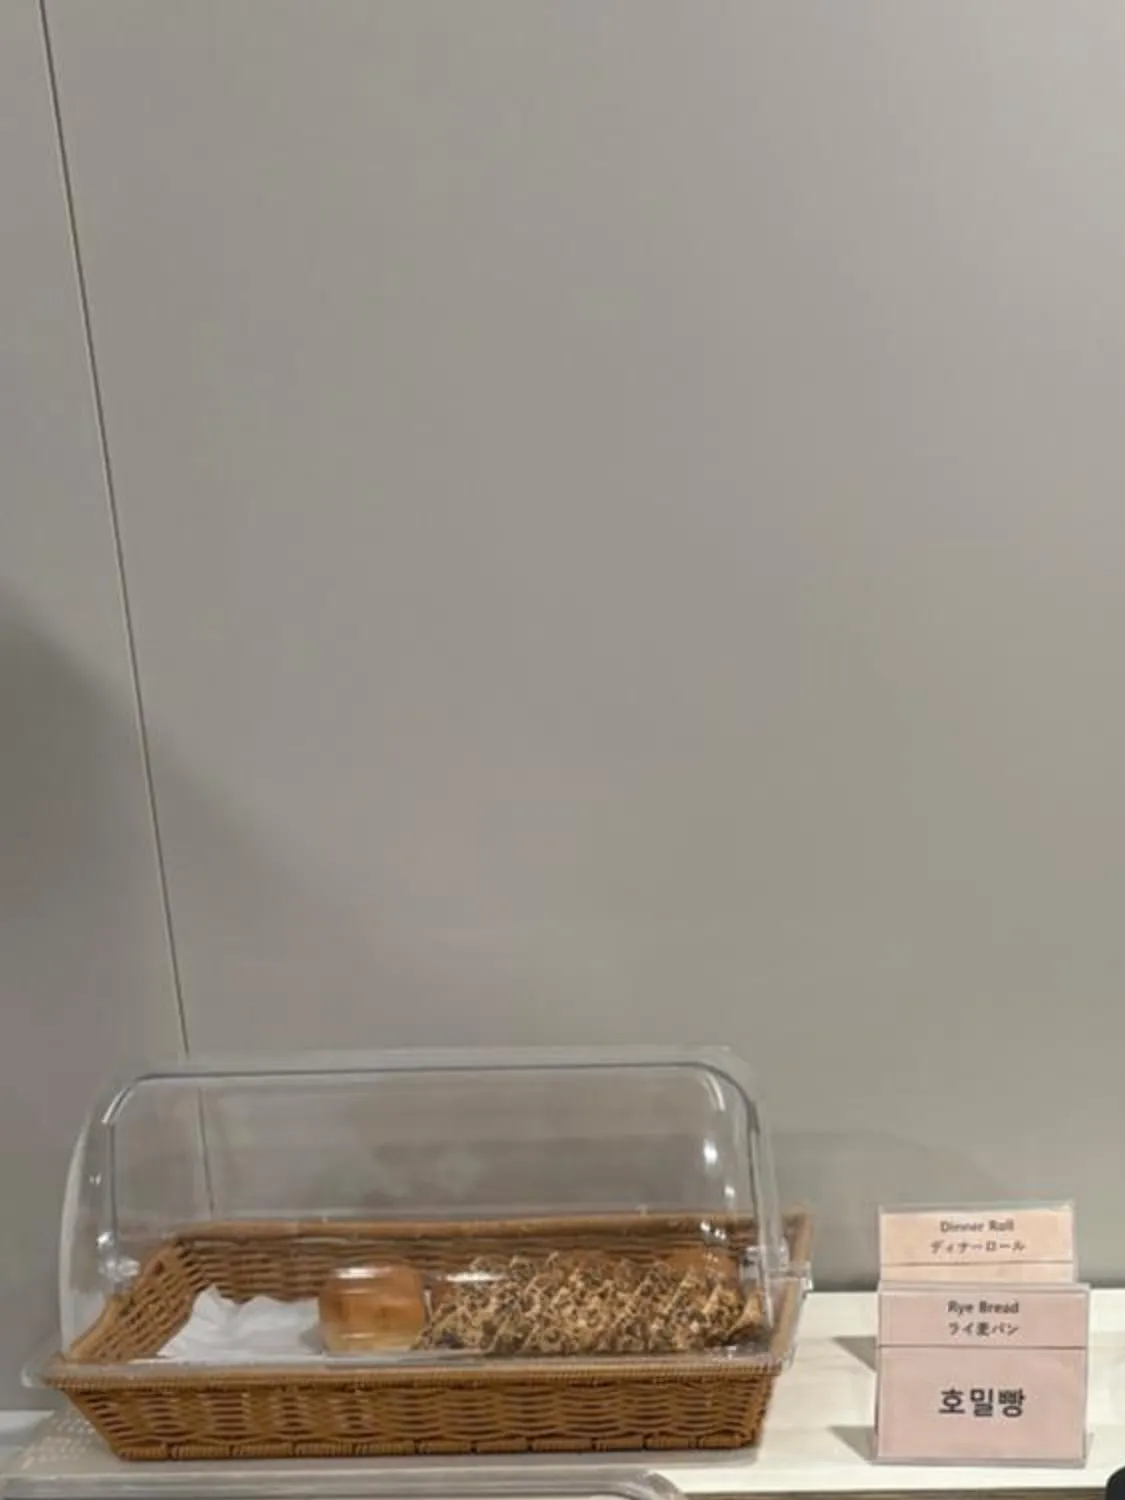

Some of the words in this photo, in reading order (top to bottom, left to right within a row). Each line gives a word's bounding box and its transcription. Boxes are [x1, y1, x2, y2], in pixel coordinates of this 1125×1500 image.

[940, 1220, 984, 1233] Dinner
[947, 1300, 974, 1317] Rye
[979, 1301, 1020, 1314] Bread
[948, 1321, 1020, 1336] ライ麦パン
[938, 1387, 1027, 1418] 호밀빵
